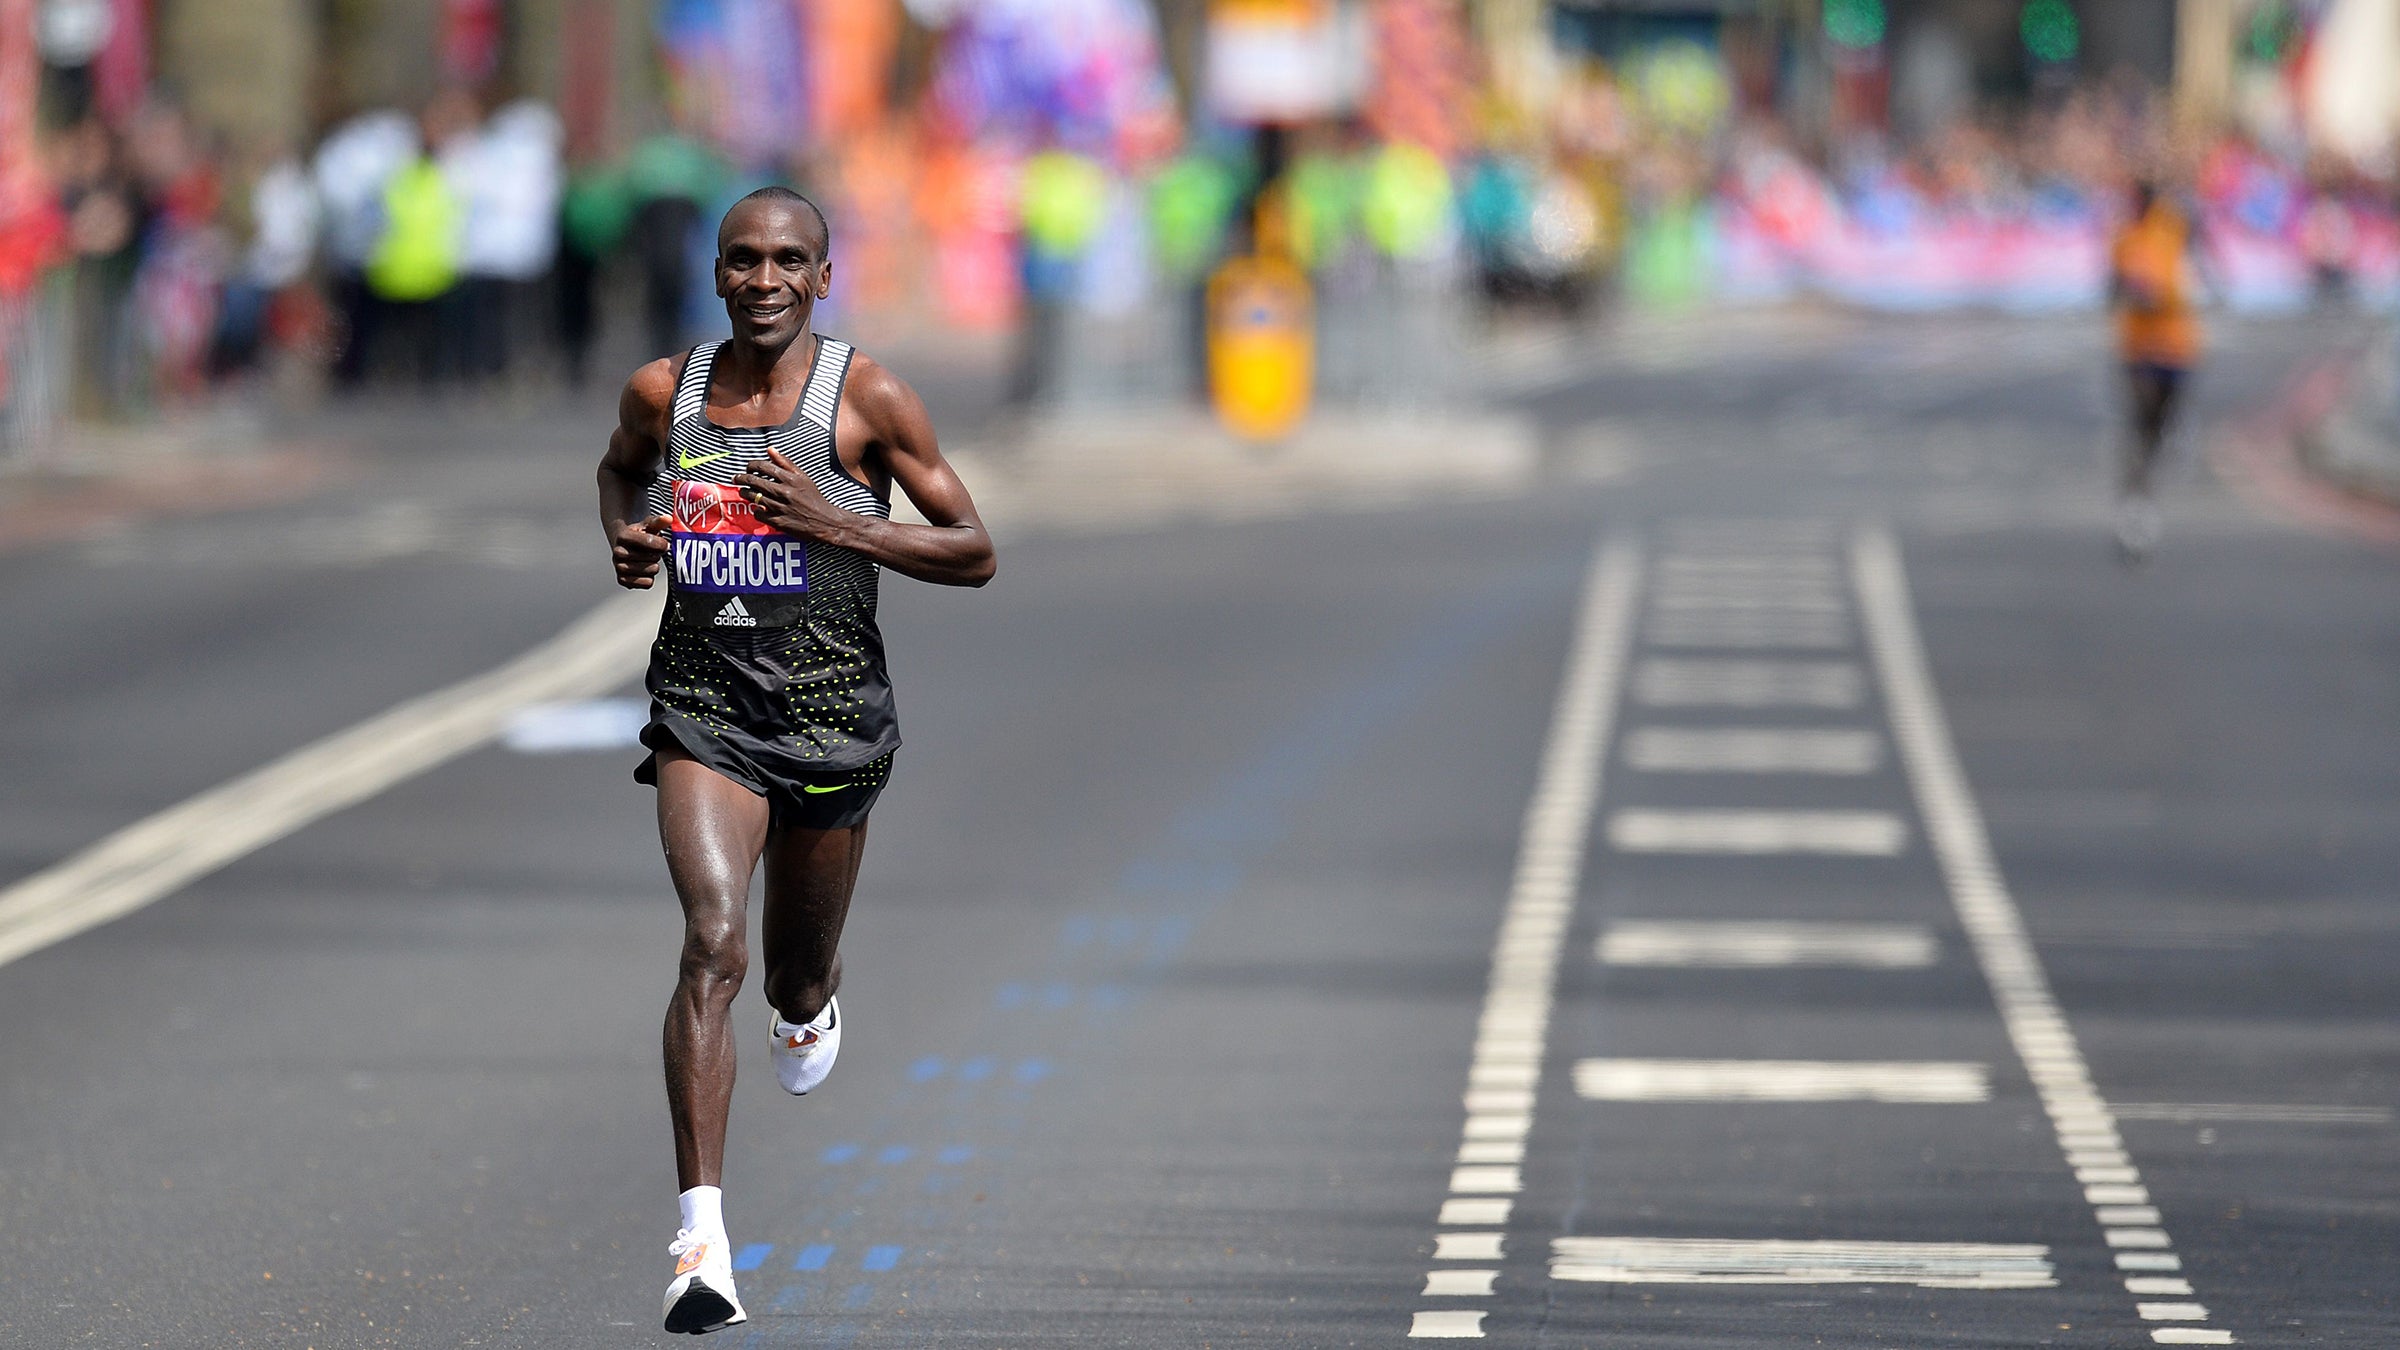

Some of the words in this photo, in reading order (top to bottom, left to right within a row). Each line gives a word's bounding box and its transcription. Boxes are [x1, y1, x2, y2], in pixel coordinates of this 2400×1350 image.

[678, 482, 718, 528] Virgin
[675, 539, 803, 587] KIPCHOGE
[713, 615, 757, 627] adidas
